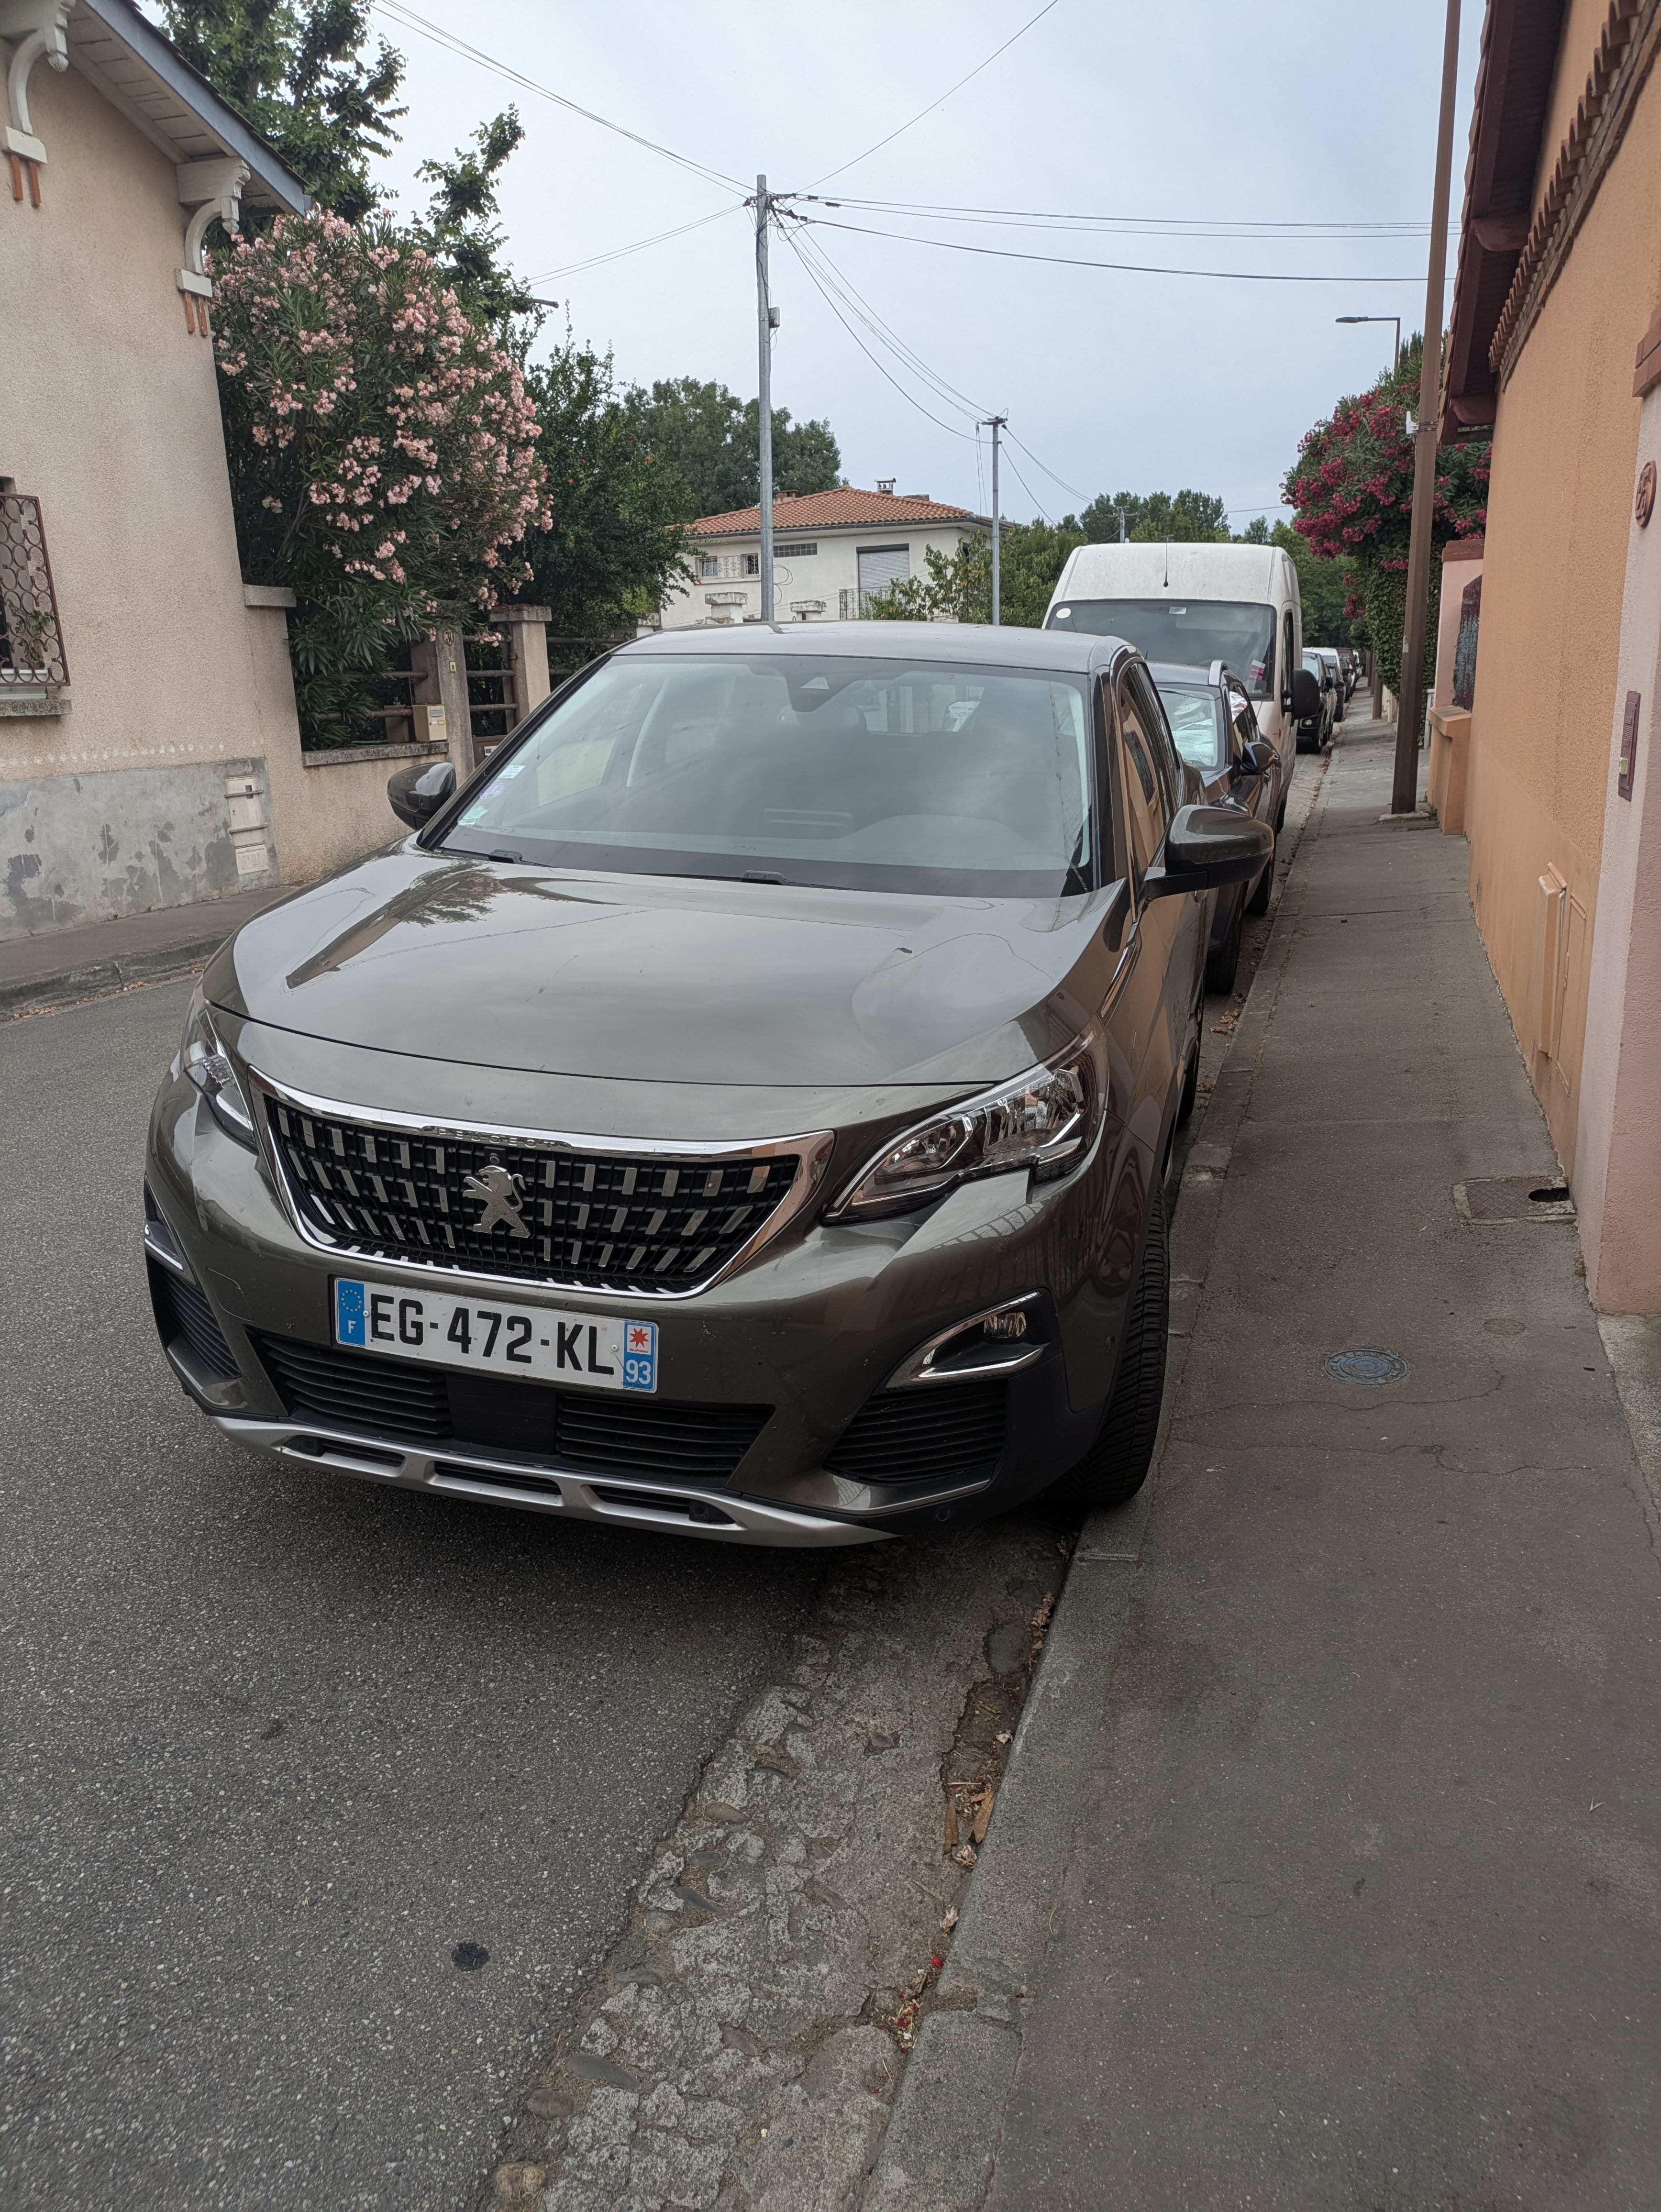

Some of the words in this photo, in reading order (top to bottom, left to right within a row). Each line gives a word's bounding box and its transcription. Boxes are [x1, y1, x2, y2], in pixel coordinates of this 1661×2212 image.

[437, 1128, 555, 1150] PEUGEOT
[348, 1320, 356, 1334] F
[370, 1293, 615, 1375] EG-472-KL
[626, 1360, 651, 1384] 93
